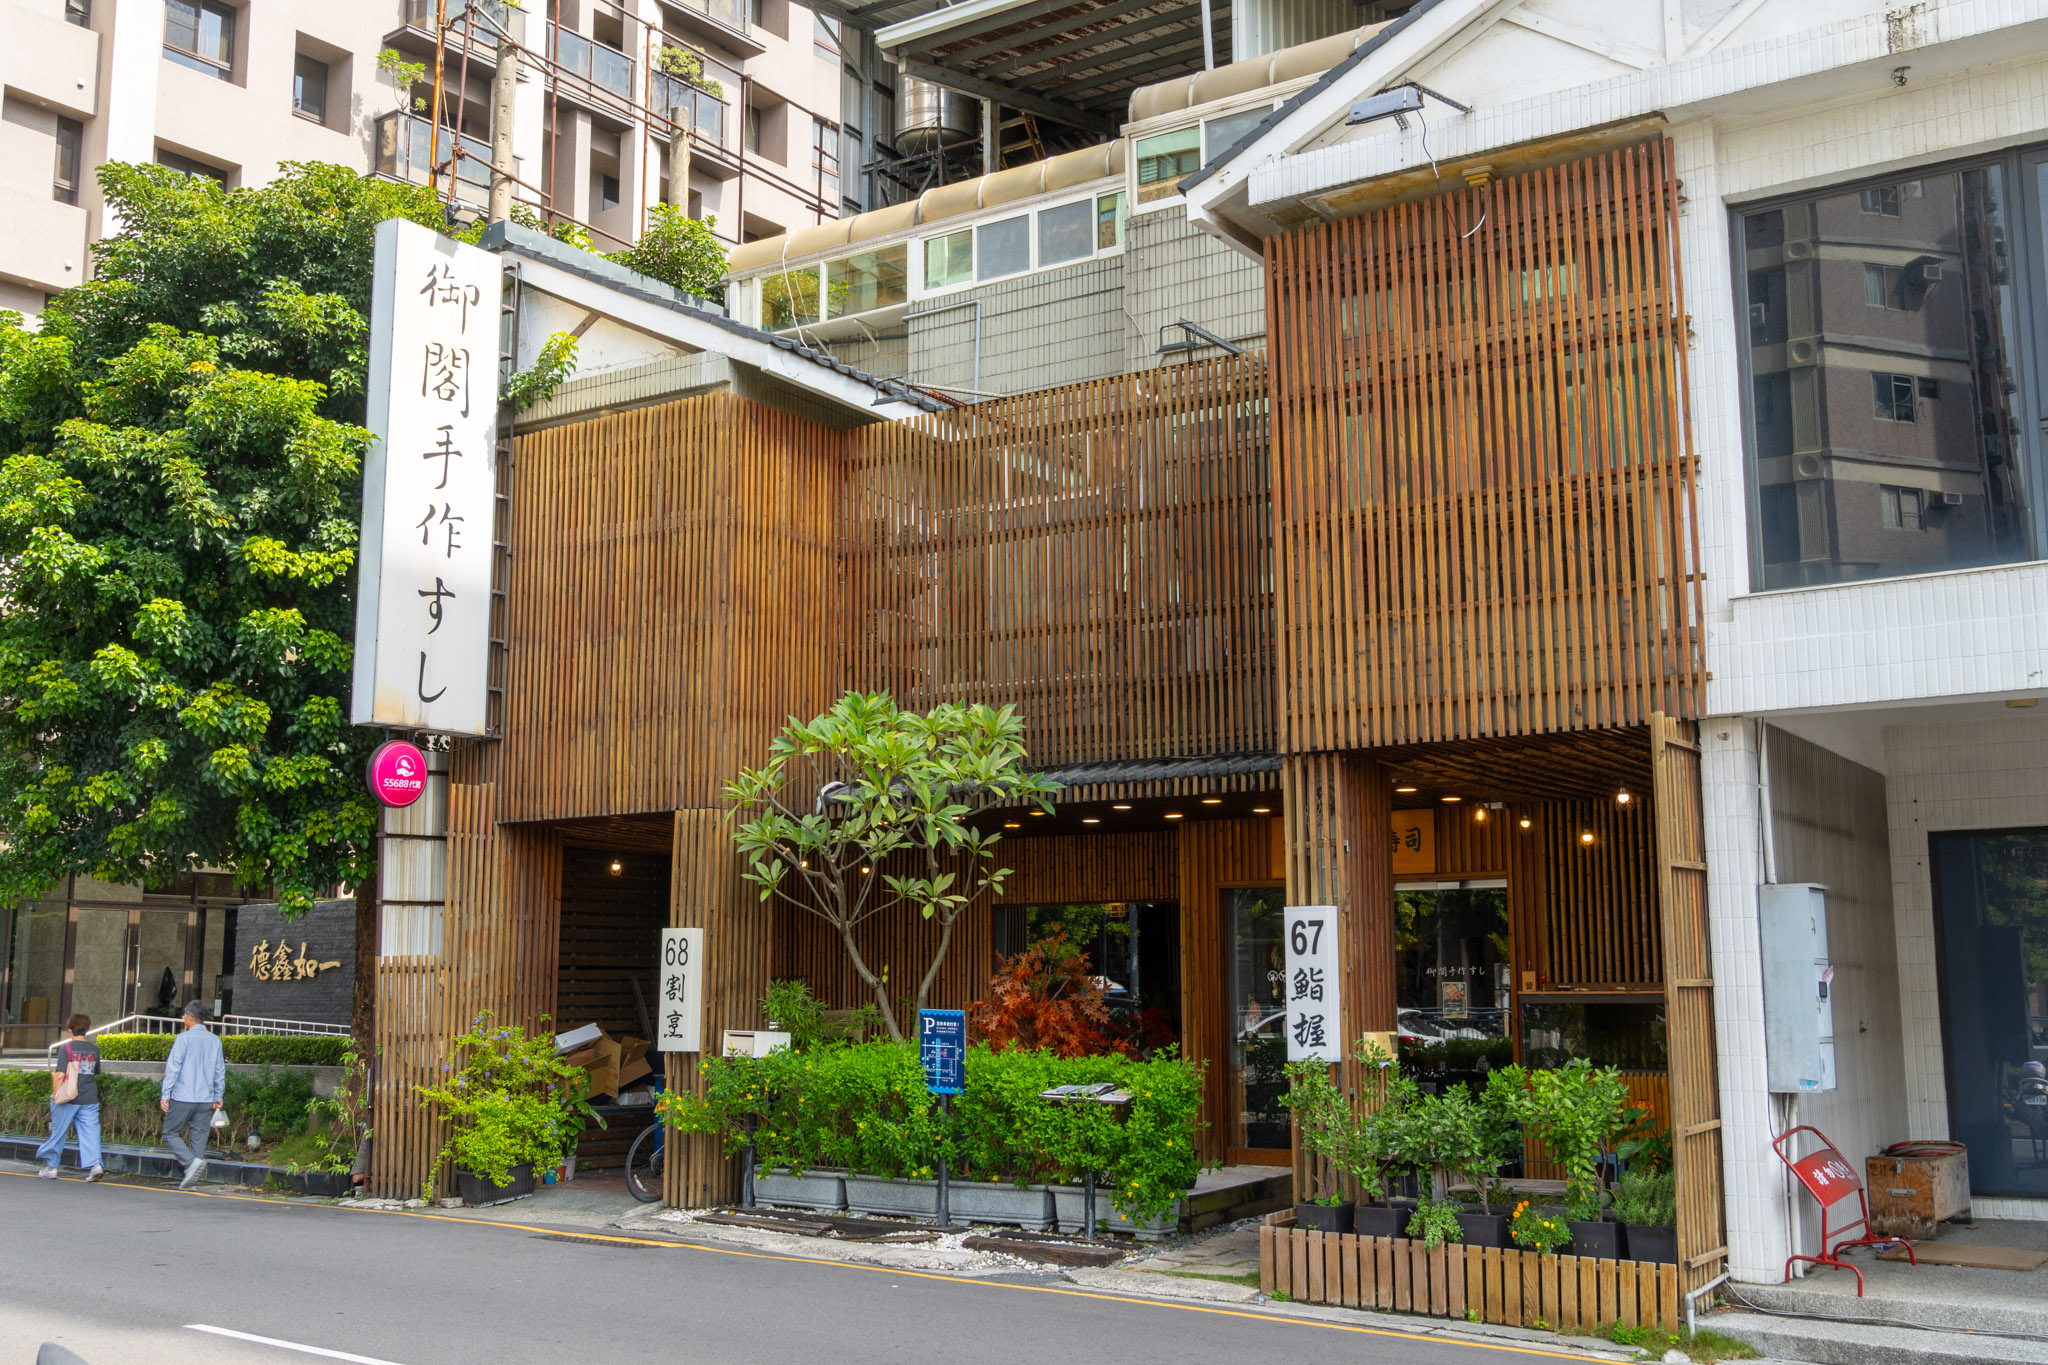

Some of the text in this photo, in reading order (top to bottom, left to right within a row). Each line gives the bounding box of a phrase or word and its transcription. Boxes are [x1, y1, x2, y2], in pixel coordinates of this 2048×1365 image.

[416, 262, 480, 703] 御閣手作すし
[665, 937, 689, 966] 68
[1291, 920, 1324, 955] 67
